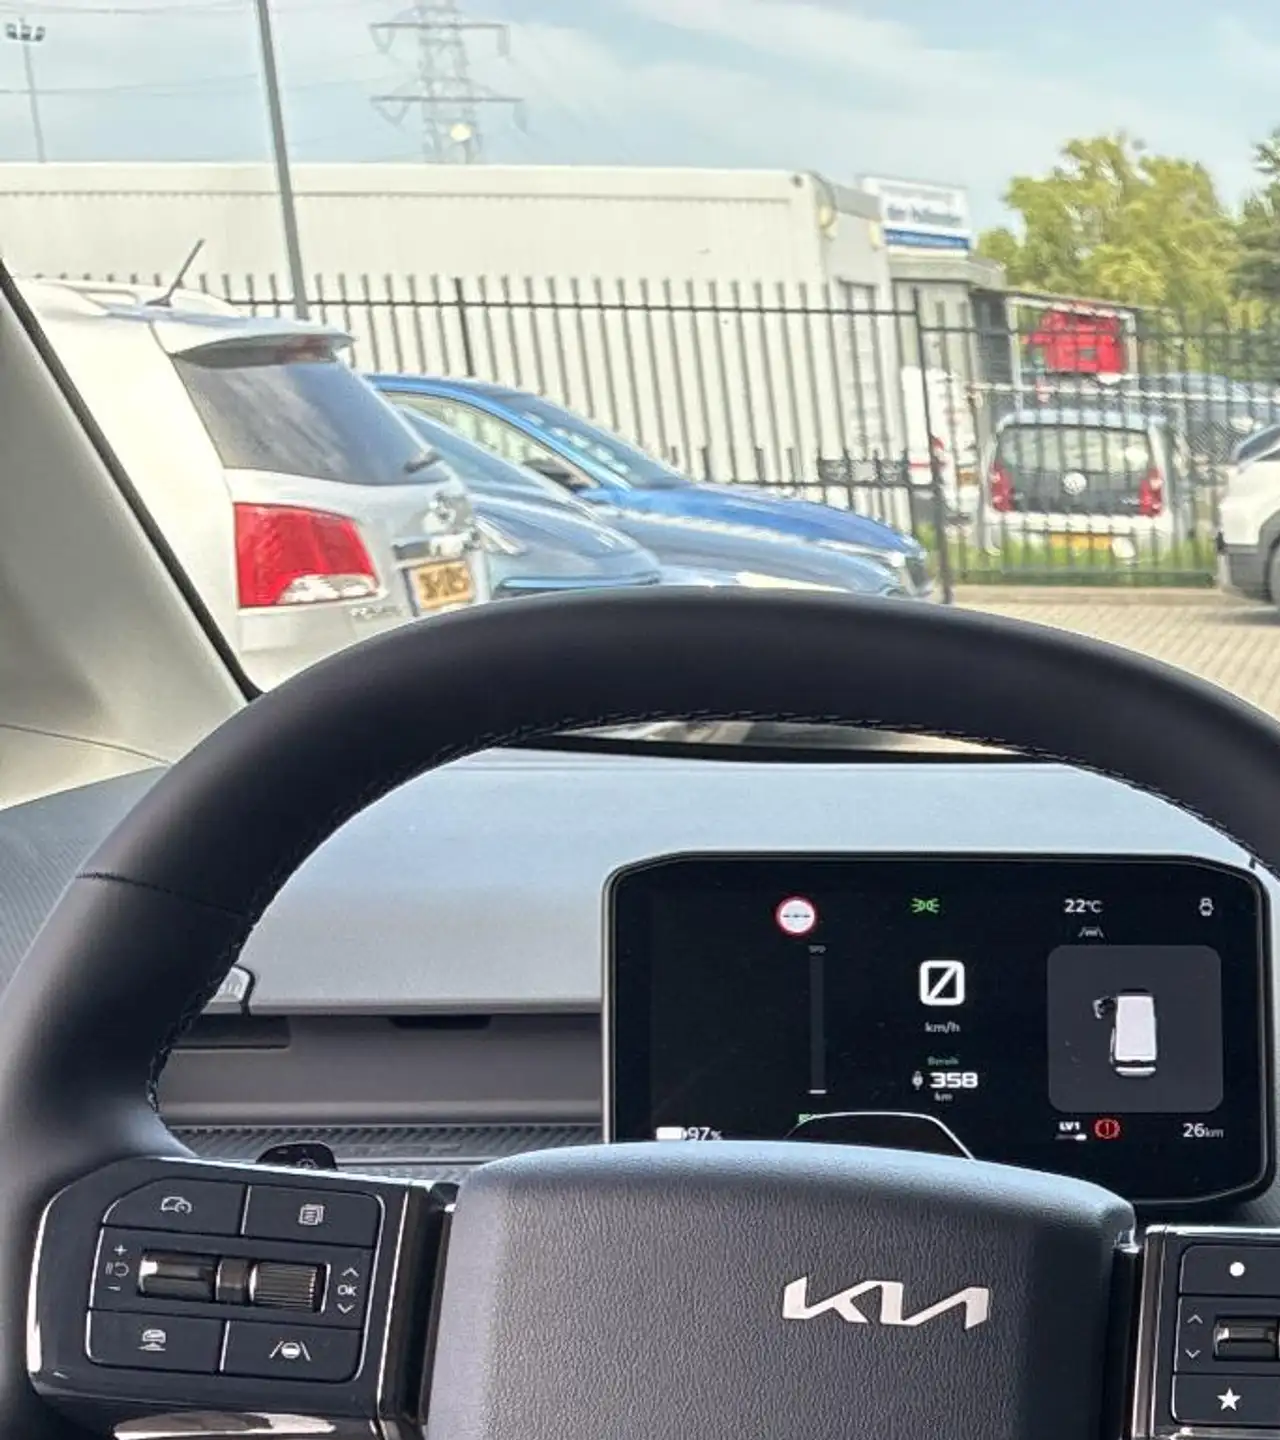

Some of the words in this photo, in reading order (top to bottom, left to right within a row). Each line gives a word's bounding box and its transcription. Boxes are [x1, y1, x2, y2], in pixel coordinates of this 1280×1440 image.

[1064, 898, 1103, 913] 22°C
[924, 1020, 961, 1034] km/h
[929, 1071, 979, 1089] 358
[934, 1091, 953, 1101] km
[337, 1284, 357, 1297] OK
[782, 1276, 990, 1329] KIA
